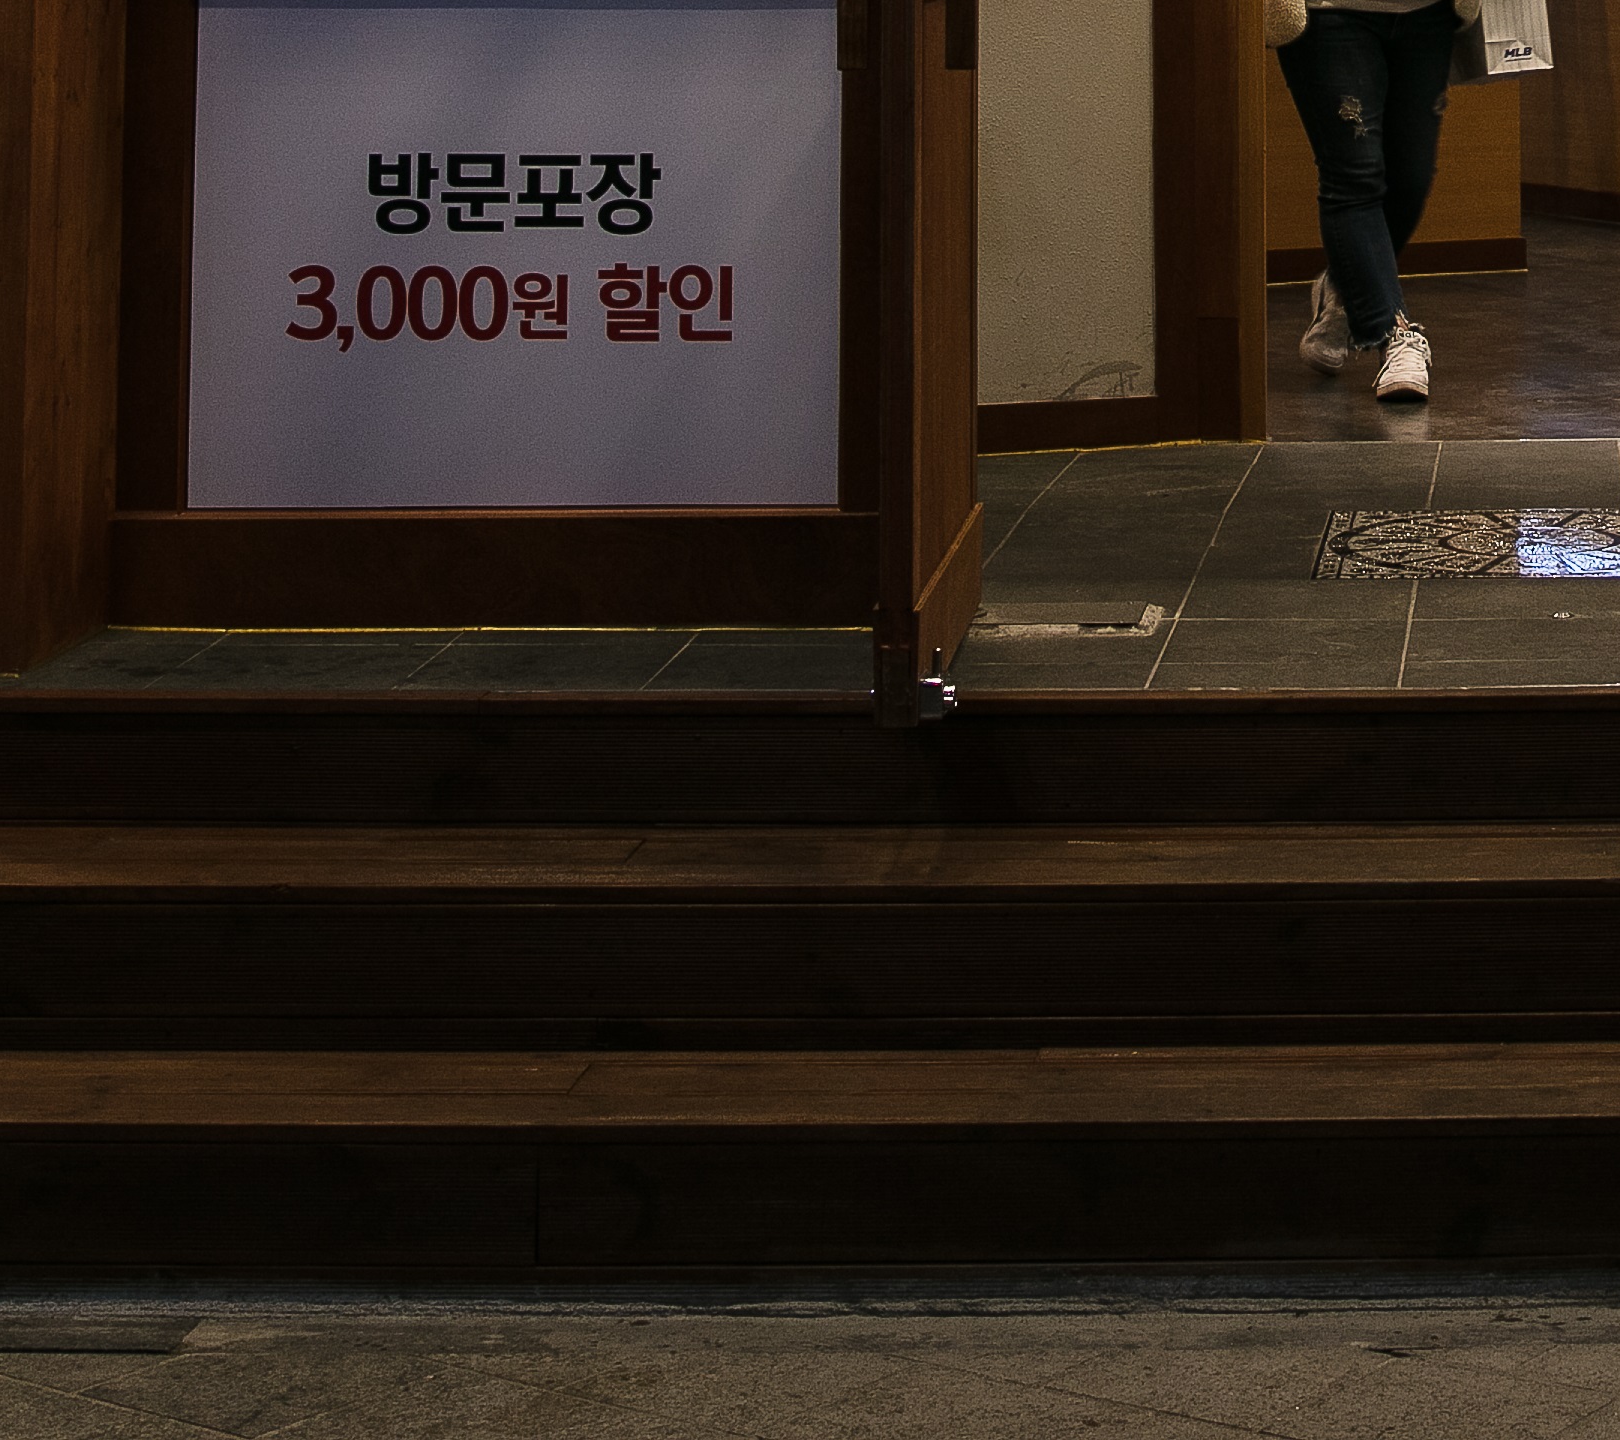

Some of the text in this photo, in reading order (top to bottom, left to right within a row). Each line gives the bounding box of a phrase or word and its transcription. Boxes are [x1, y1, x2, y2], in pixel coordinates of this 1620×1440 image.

[1503, 47, 1533, 58] MLB
[366, 152, 661, 235] 방문포장
[284, 262, 734, 353] 3,000원 할인
